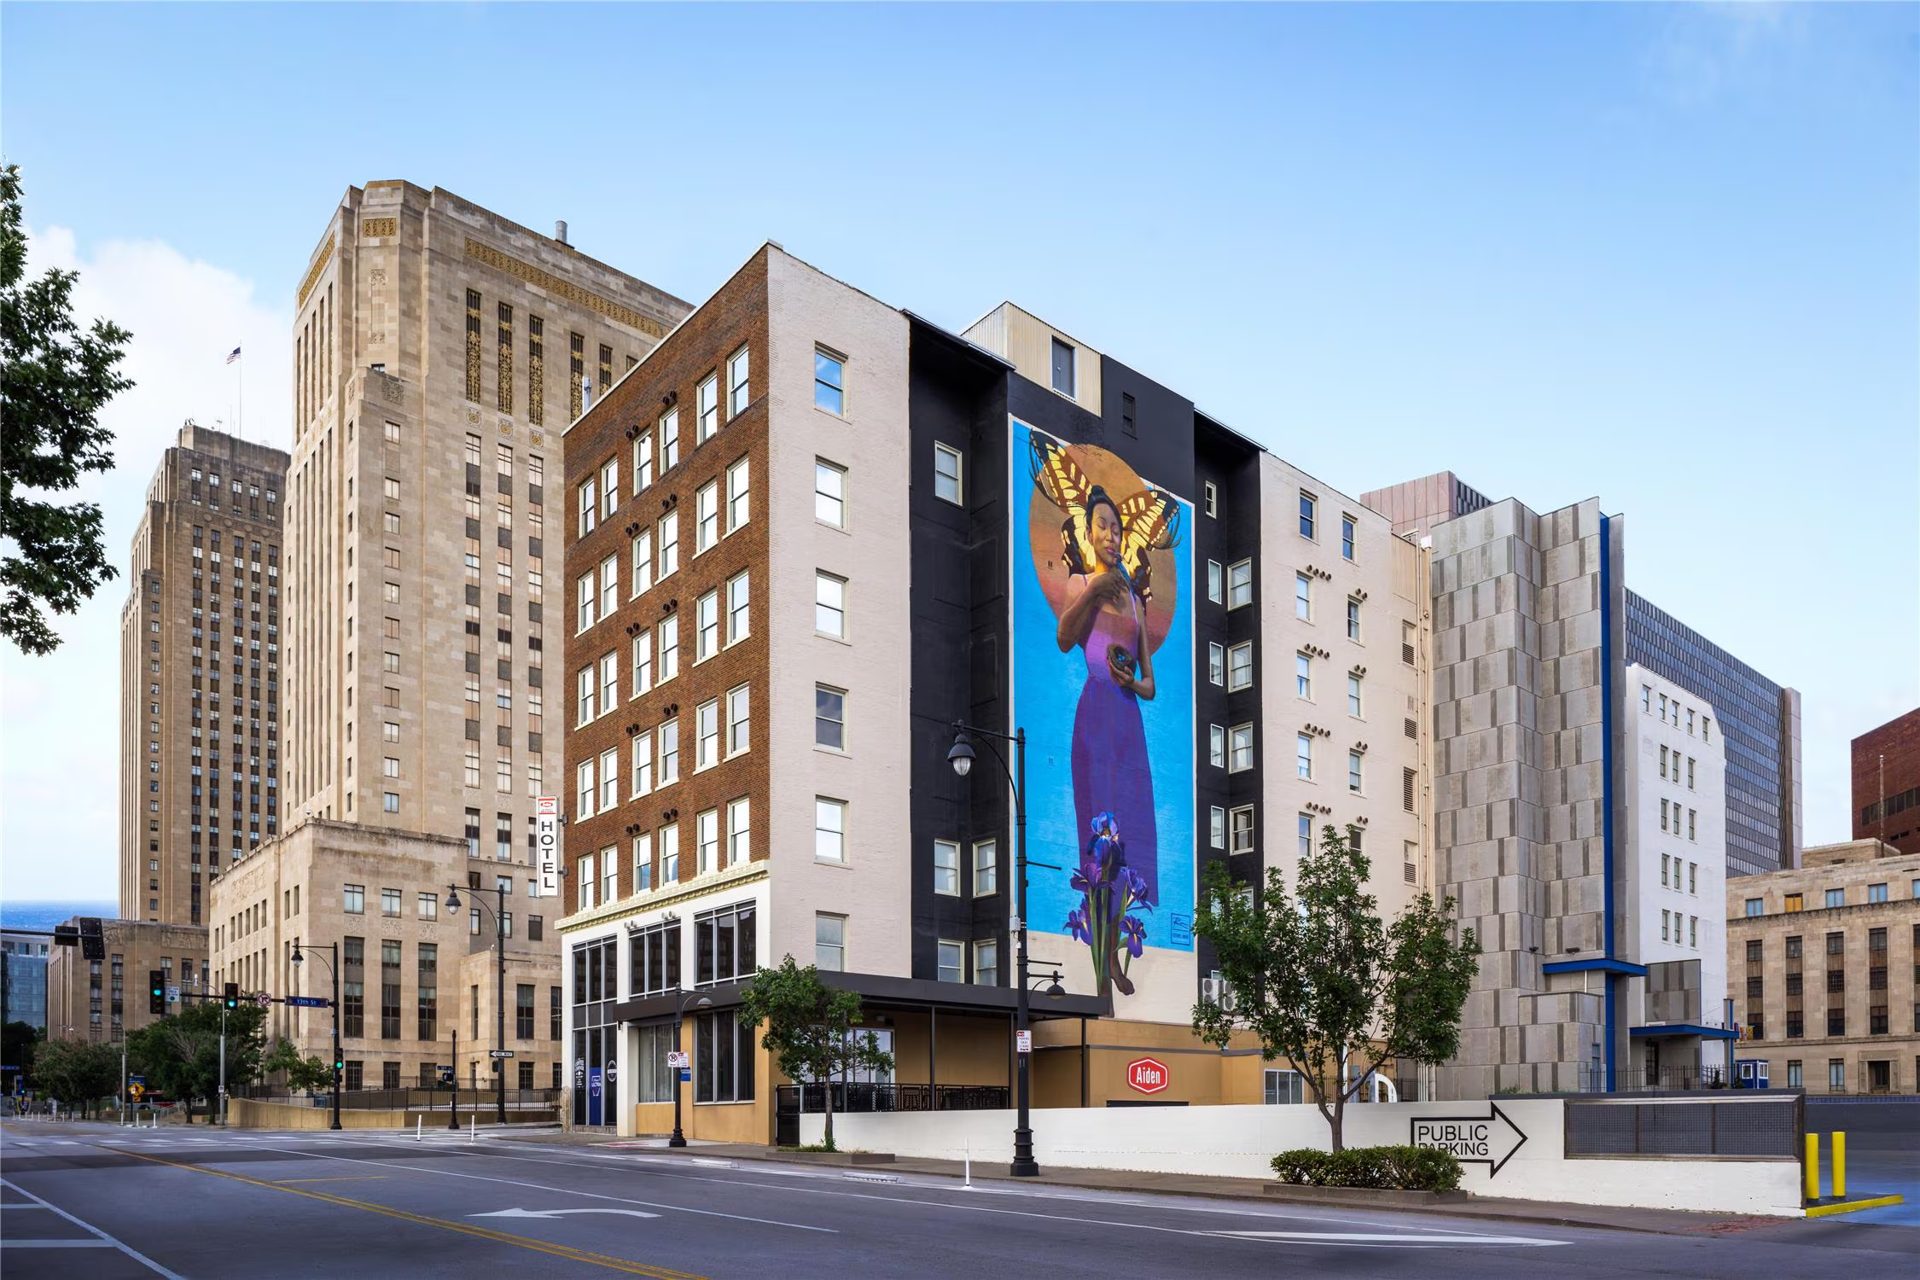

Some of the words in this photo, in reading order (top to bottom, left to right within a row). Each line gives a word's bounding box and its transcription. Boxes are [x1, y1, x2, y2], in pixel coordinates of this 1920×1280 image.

[541, 821, 555, 888] HOTEL
[1136, 1066, 1161, 1084] Aiden
[1418, 1124, 1488, 1141] PUBLIC
